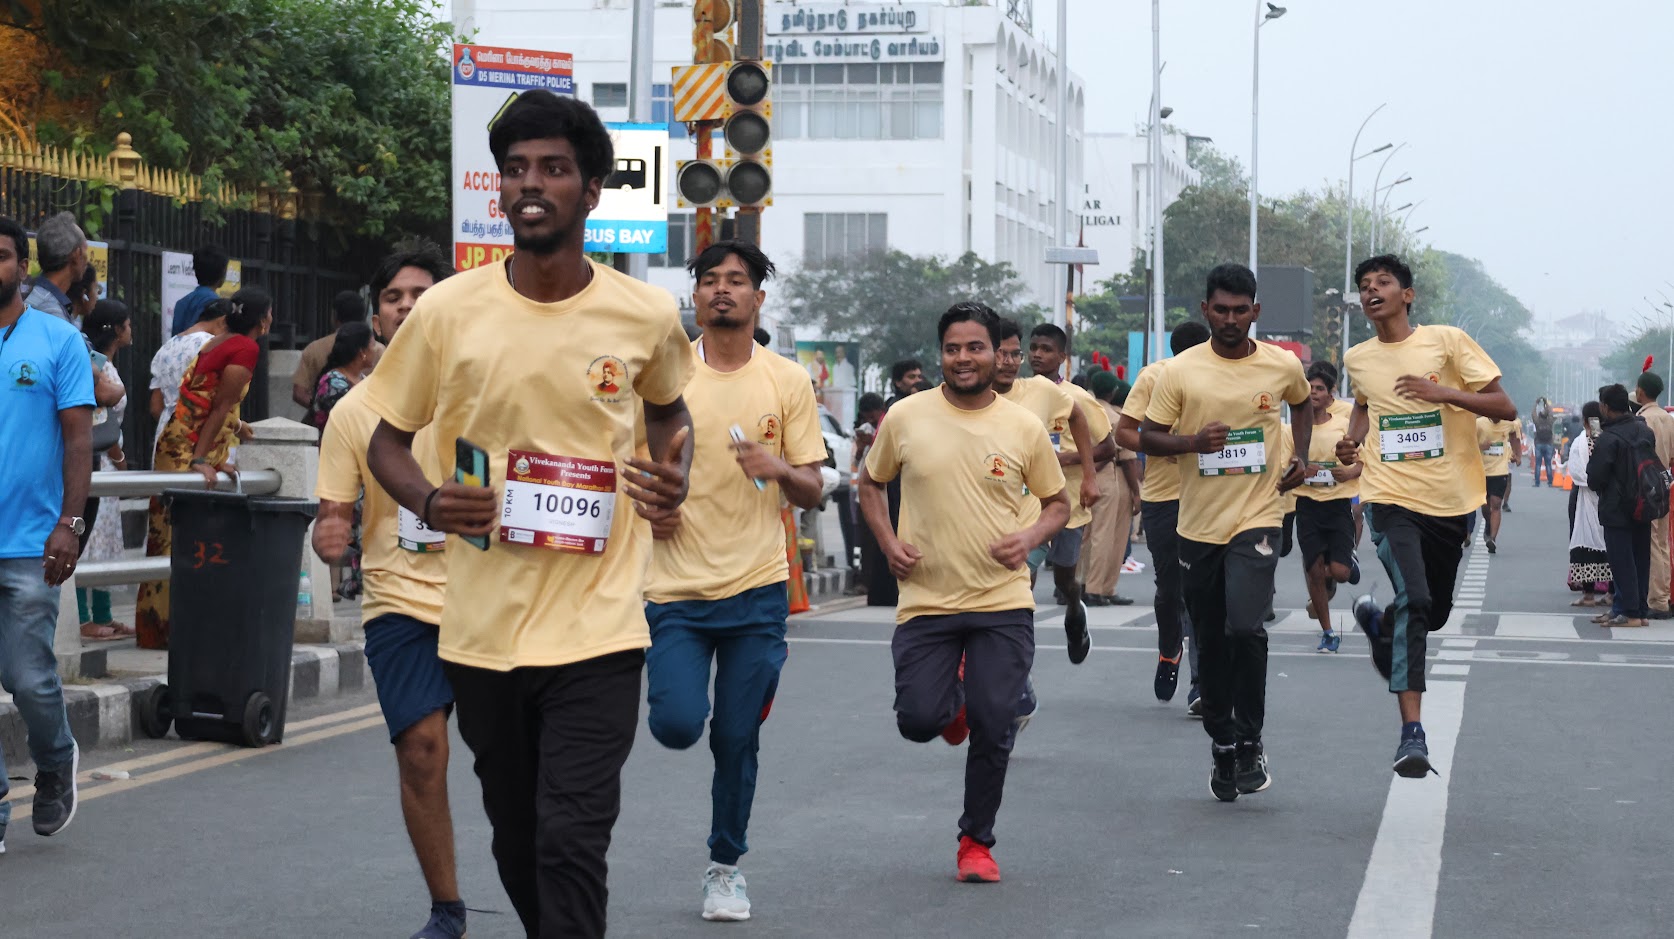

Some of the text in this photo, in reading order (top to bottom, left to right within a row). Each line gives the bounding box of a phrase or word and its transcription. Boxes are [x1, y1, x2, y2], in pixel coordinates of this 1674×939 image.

[782, 8, 848, 31] தமிழ்நாடு
[813, 38, 881, 60] மேம்பாட்டு
[888, 36, 939, 56] வாரியம்
[478, 71, 571, 89] D5 MERINA TRAFFIC POLICE
[462, 219, 486, 238] விபத்து
[584, 228, 654, 244] BUS BAY
[461, 246, 486, 269] JP
[1397, 432, 1427, 444] 3405
[1218, 447, 1247, 459] 3819
[529, 456, 575, 469] Vivekananda
[577, 462, 599, 472] Youth
[561, 469, 591, 479] Presents
[504, 489, 514, 517] 10 KM
[534, 493, 600, 518] 10096
[193, 541, 229, 569] 32
